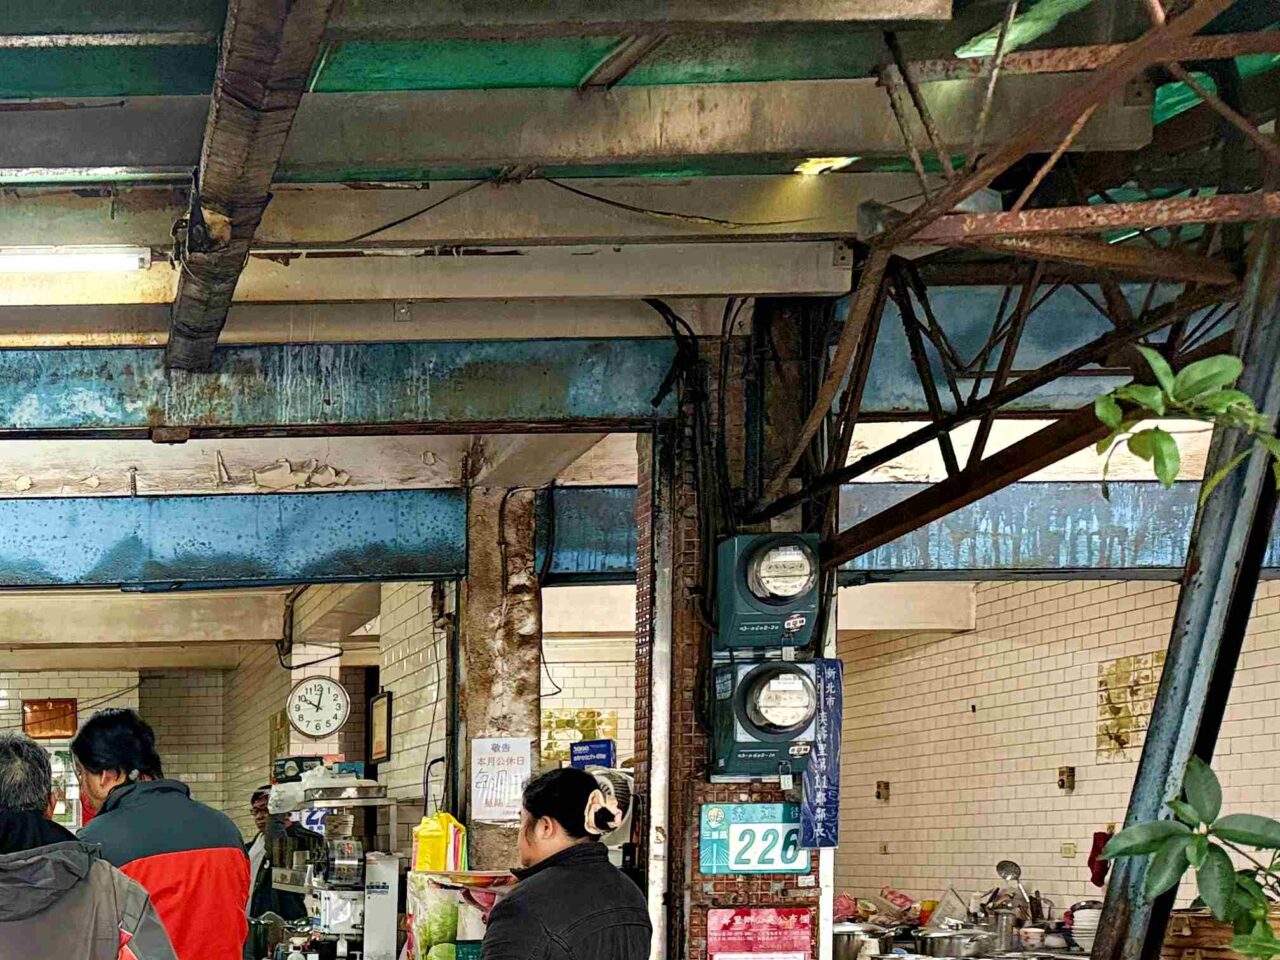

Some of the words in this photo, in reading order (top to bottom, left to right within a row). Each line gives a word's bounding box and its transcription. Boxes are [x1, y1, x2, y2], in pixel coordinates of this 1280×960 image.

[305, 687, 312, 695] 11
[333, 693, 339, 702] 2
[295, 704, 301, 712] 9
[335, 703, 341, 711] 3
[305, 720, 311, 728] 7
[315, 723, 321, 731] 6
[325, 720, 332, 728] 5
[491, 743, 511, 752] 敬告
[477, 756, 525, 766] 本月公休日
[734, 828, 801, 865] 226
